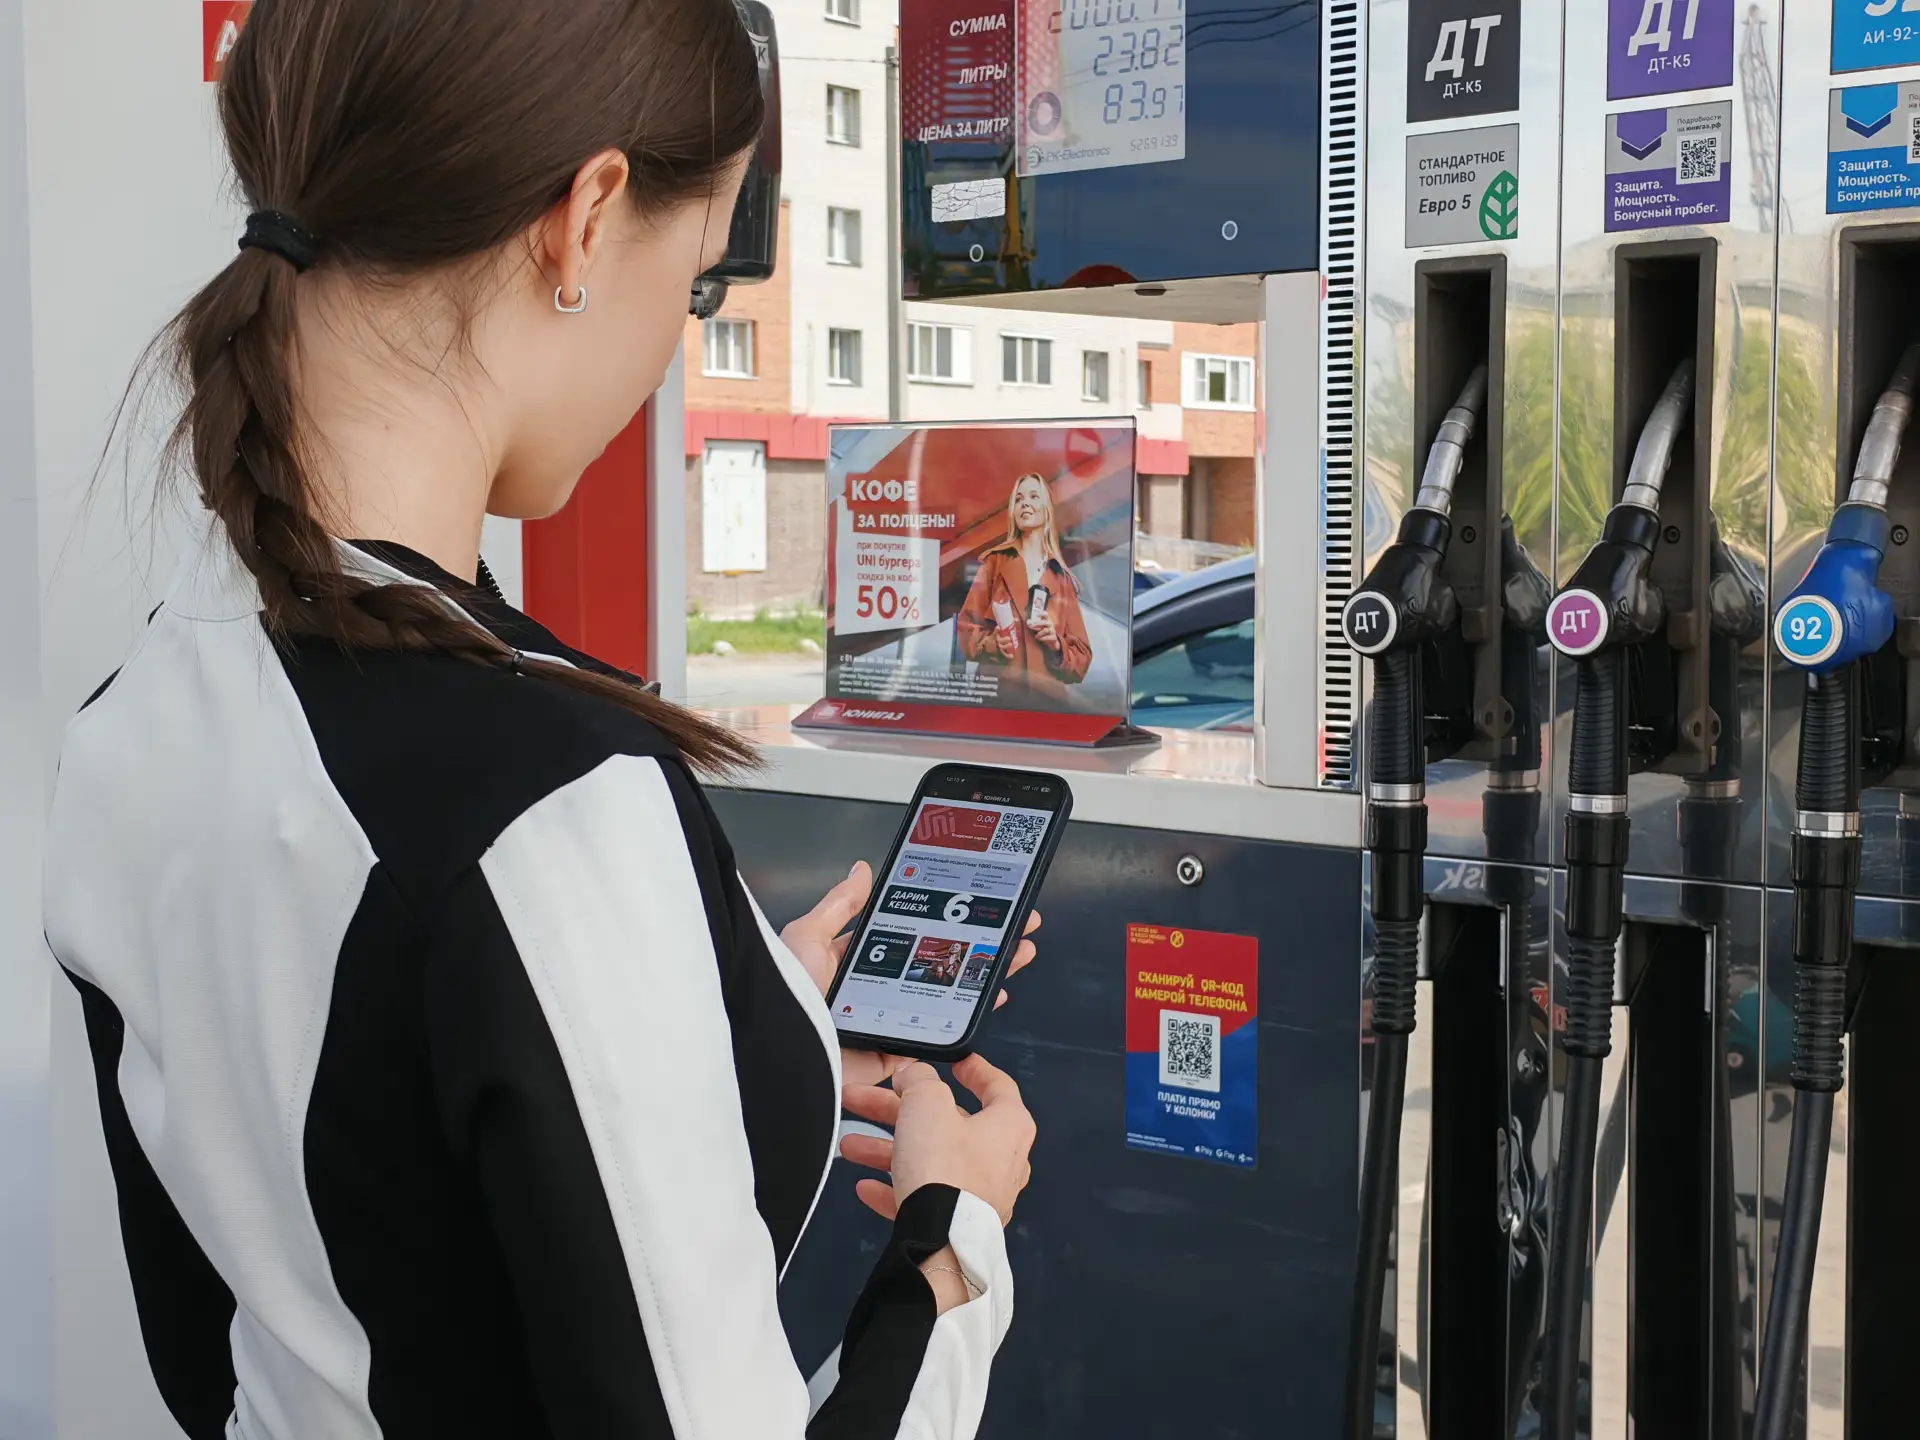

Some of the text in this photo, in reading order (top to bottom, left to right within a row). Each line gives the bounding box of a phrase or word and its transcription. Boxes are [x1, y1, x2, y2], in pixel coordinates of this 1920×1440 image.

[949, 13, 1007, 36] СУММА
[1093, 24, 1183, 76] 23.82
[1425, 14, 1502, 81] ДТ
[959, 62, 1008, 85] ЛИТРЫ
[1647, 54, 1691, 74] ДТ-К5
[1443, 79, 1482, 99] ДТ-К5
[1103, 81, 1184, 124] 83.97
[1677, 115, 1722, 125] Подробности
[1686, 122, 1722, 132] юнигаз.рф
[919, 117, 1009, 144] ЦЕНА ЗА ЛИТР
[1419, 150, 1506, 170] СТАНДАРТНОЕ
[1838, 159, 1893, 173] Защита.
[1419, 171, 1476, 187] ТОПЛИВО
[1614, 180, 1663, 193] Защита.
[1837, 173, 1911, 188] Мощность.
[1614, 193, 1680, 208] Мощность.
[1837, 186, 1902, 203] Бонусный
[1419, 194, 1472, 216] Евро 5
[1614, 202, 1719, 222] Бонусный пробег.
[851, 479, 917, 502] КОФЕ
[857, 513, 956, 530] ЗА ПОЛЦЕНЫ!
[857, 542, 906, 553] при покупке
[857, 554, 921, 570] UNI бургера
[857, 573, 919, 583] скидка на коф
[856, 585, 920, 620] 50%
[1354, 610, 1380, 635] ДТ
[1560, 609, 1591, 635] ДТ
[1790, 616, 1822, 641] 92
[842, 708, 905, 721] ЮНИГАЗ
[891, 890, 929, 902] ДАРИМ
[887, 900, 931, 913] КЕШБЭК
[943, 892, 975, 923] 6
[868, 944, 888, 963] 6
[1138, 971, 1244, 997] СКАНИРУЙ QR-КОД
[1135, 987, 1248, 1012] КАМЕРОЙ ТЕЛЕФОНА
[1157, 1091, 1221, 1111] ПЛАТИ ПРЯМО
[1165, 1103, 1216, 1120] У КОЛОНКИ
